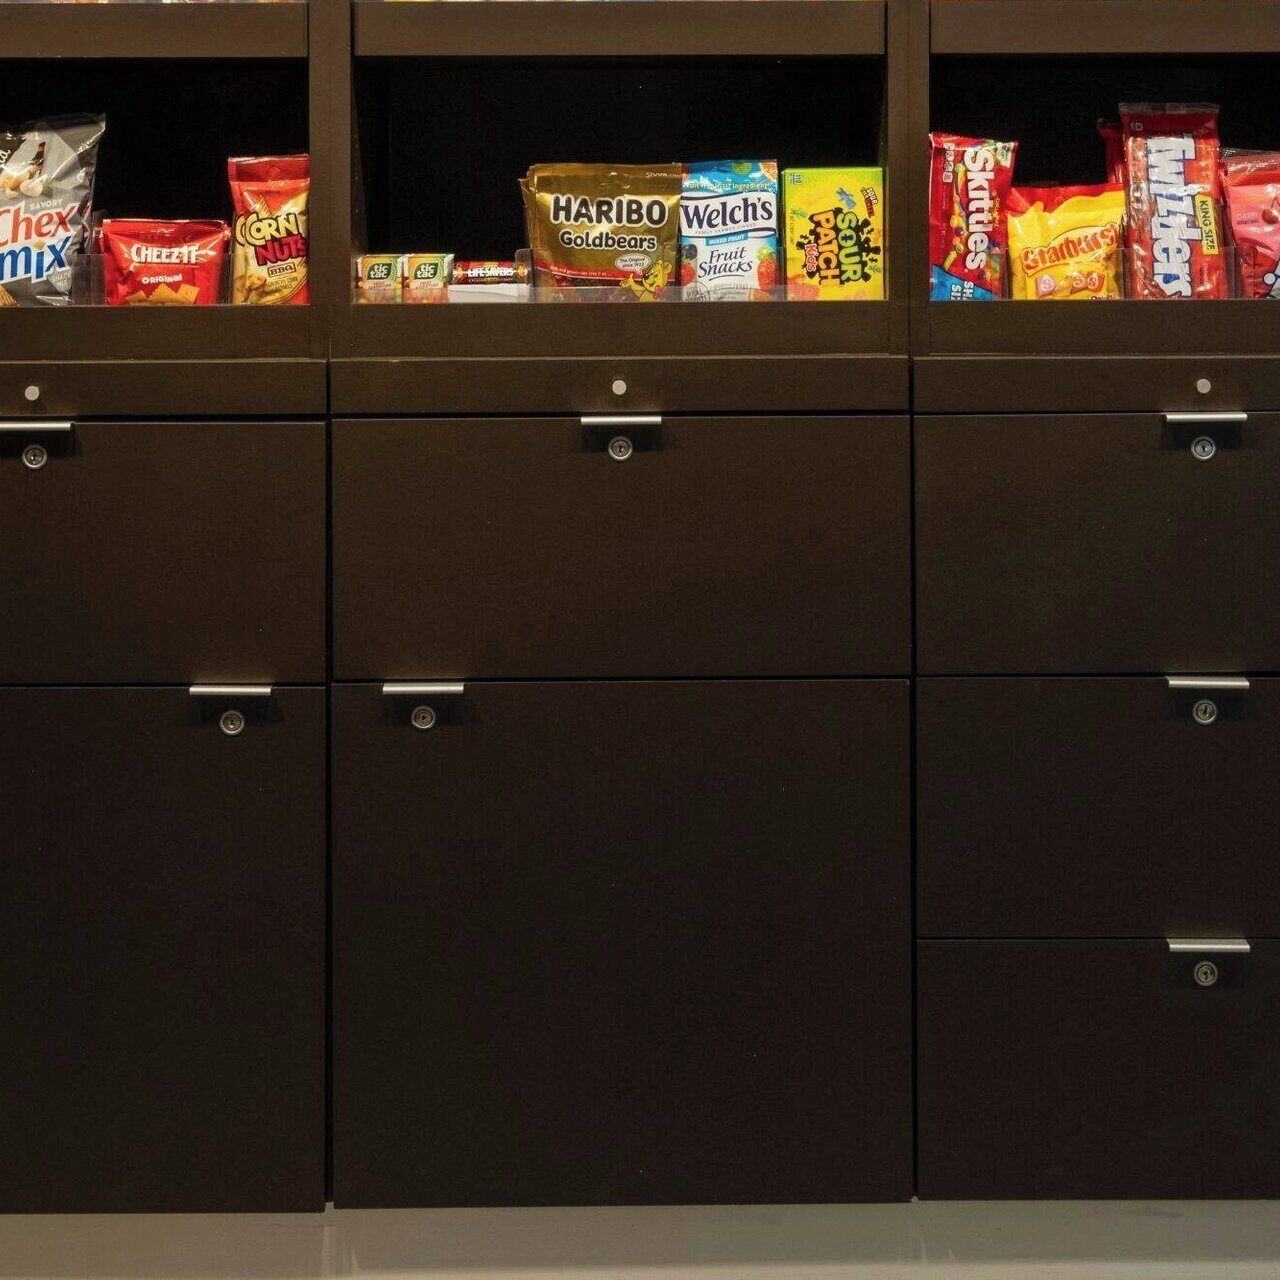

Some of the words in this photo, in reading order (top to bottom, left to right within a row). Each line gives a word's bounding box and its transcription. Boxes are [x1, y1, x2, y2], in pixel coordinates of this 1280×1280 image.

[28, 198, 64, 210] SAVORY
[551, 194, 667, 226] HARIBO
[680, 197, 774, 229] Welch's
[964, 147, 995, 270] Skittles
[1146, 132, 1203, 298] Twizzlers
[1199, 199, 1208, 226] KING
[244, 212, 300, 247] CORN
[560, 229, 658, 251] Goldbears
[1202, 226, 1216, 251] SIZE
[709, 246, 748, 264] Fruit
[805, 243, 819, 272] Kids
[812, 209, 840, 287] PATCH
[836, 211, 862, 281] SOUR
[269, 264, 295, 276] BBQ
[370, 271, 388, 279] tac
[373, 263, 388, 271] tic
[416, 271, 434, 279] tac
[420, 263, 435, 271] tic
[698, 260, 754, 278] Snacks
